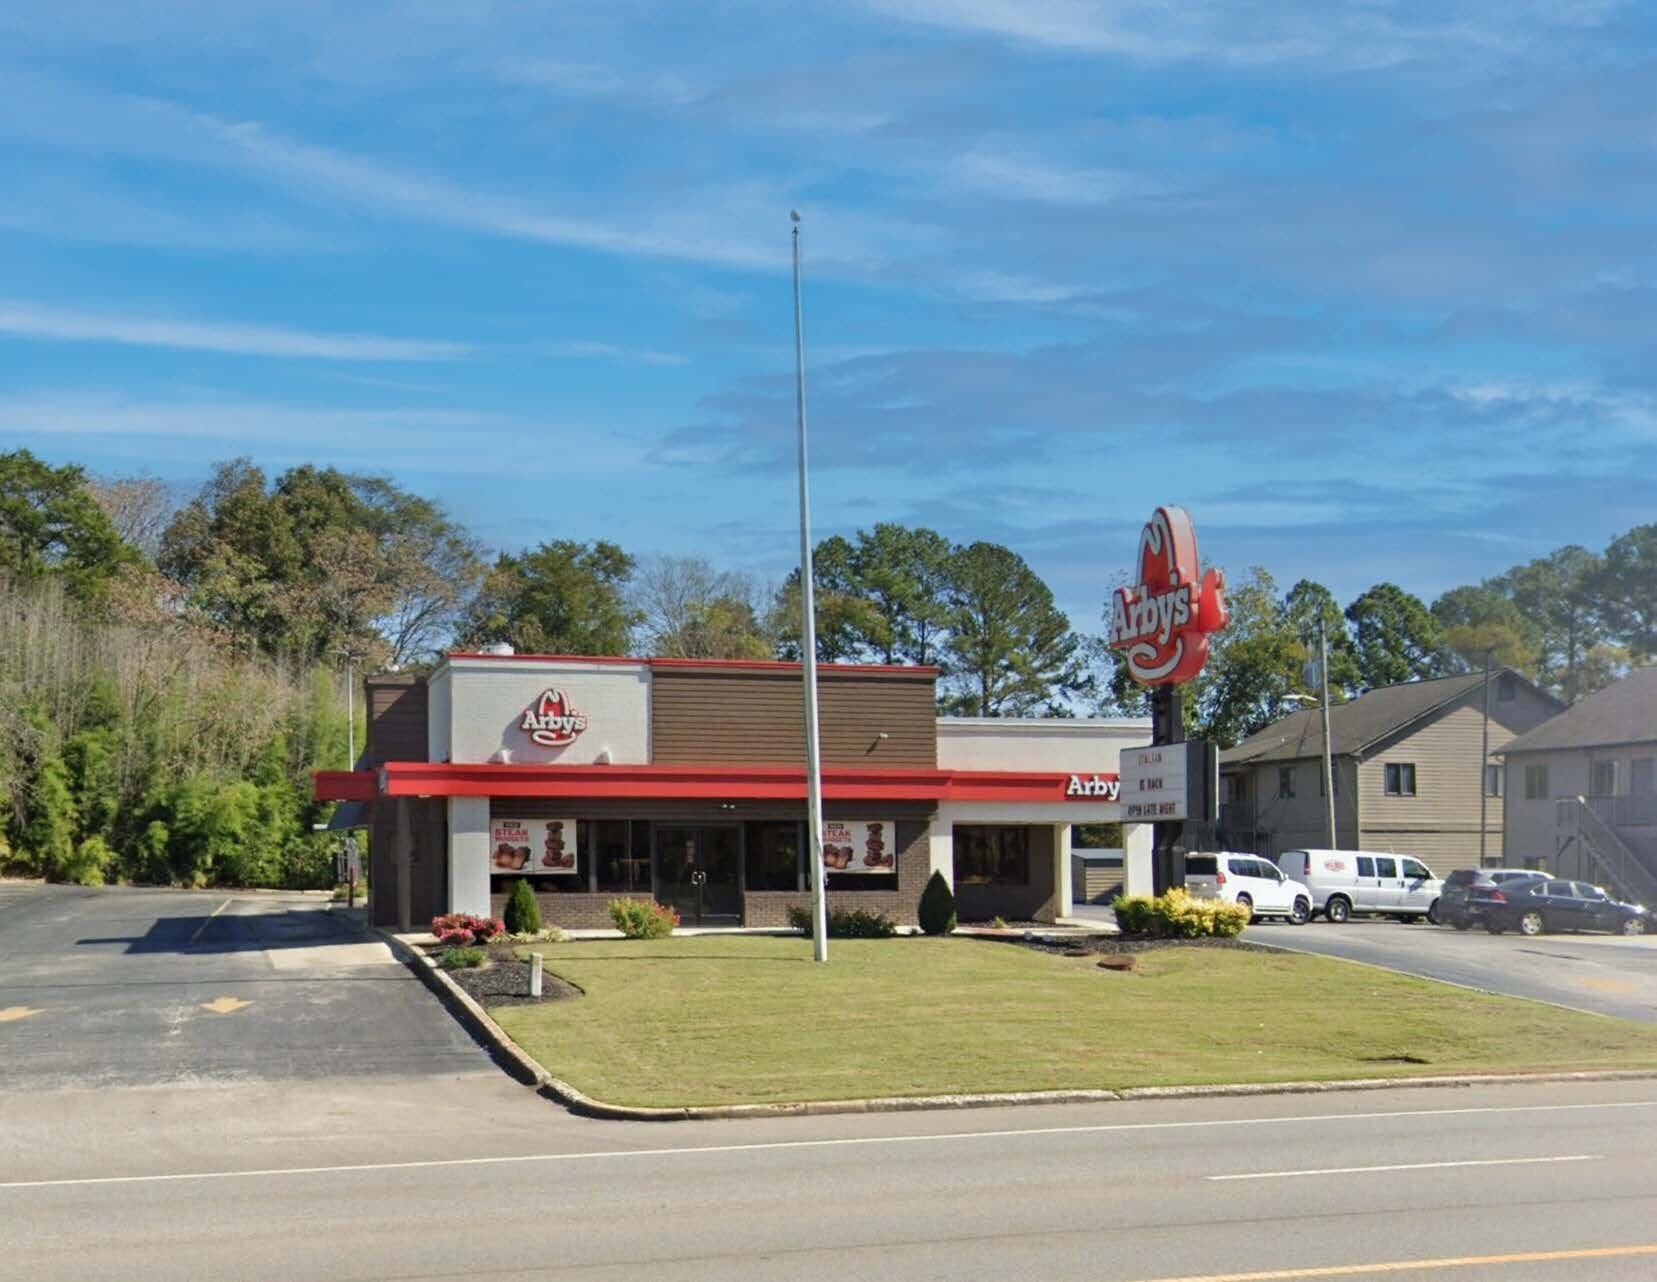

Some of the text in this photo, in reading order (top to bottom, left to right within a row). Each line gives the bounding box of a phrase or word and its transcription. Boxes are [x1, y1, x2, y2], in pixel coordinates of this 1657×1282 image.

[1110, 571, 1191, 646] Arby's
[521, 709, 588, 736] Arby's
[495, 829, 528, 837] STEAK
